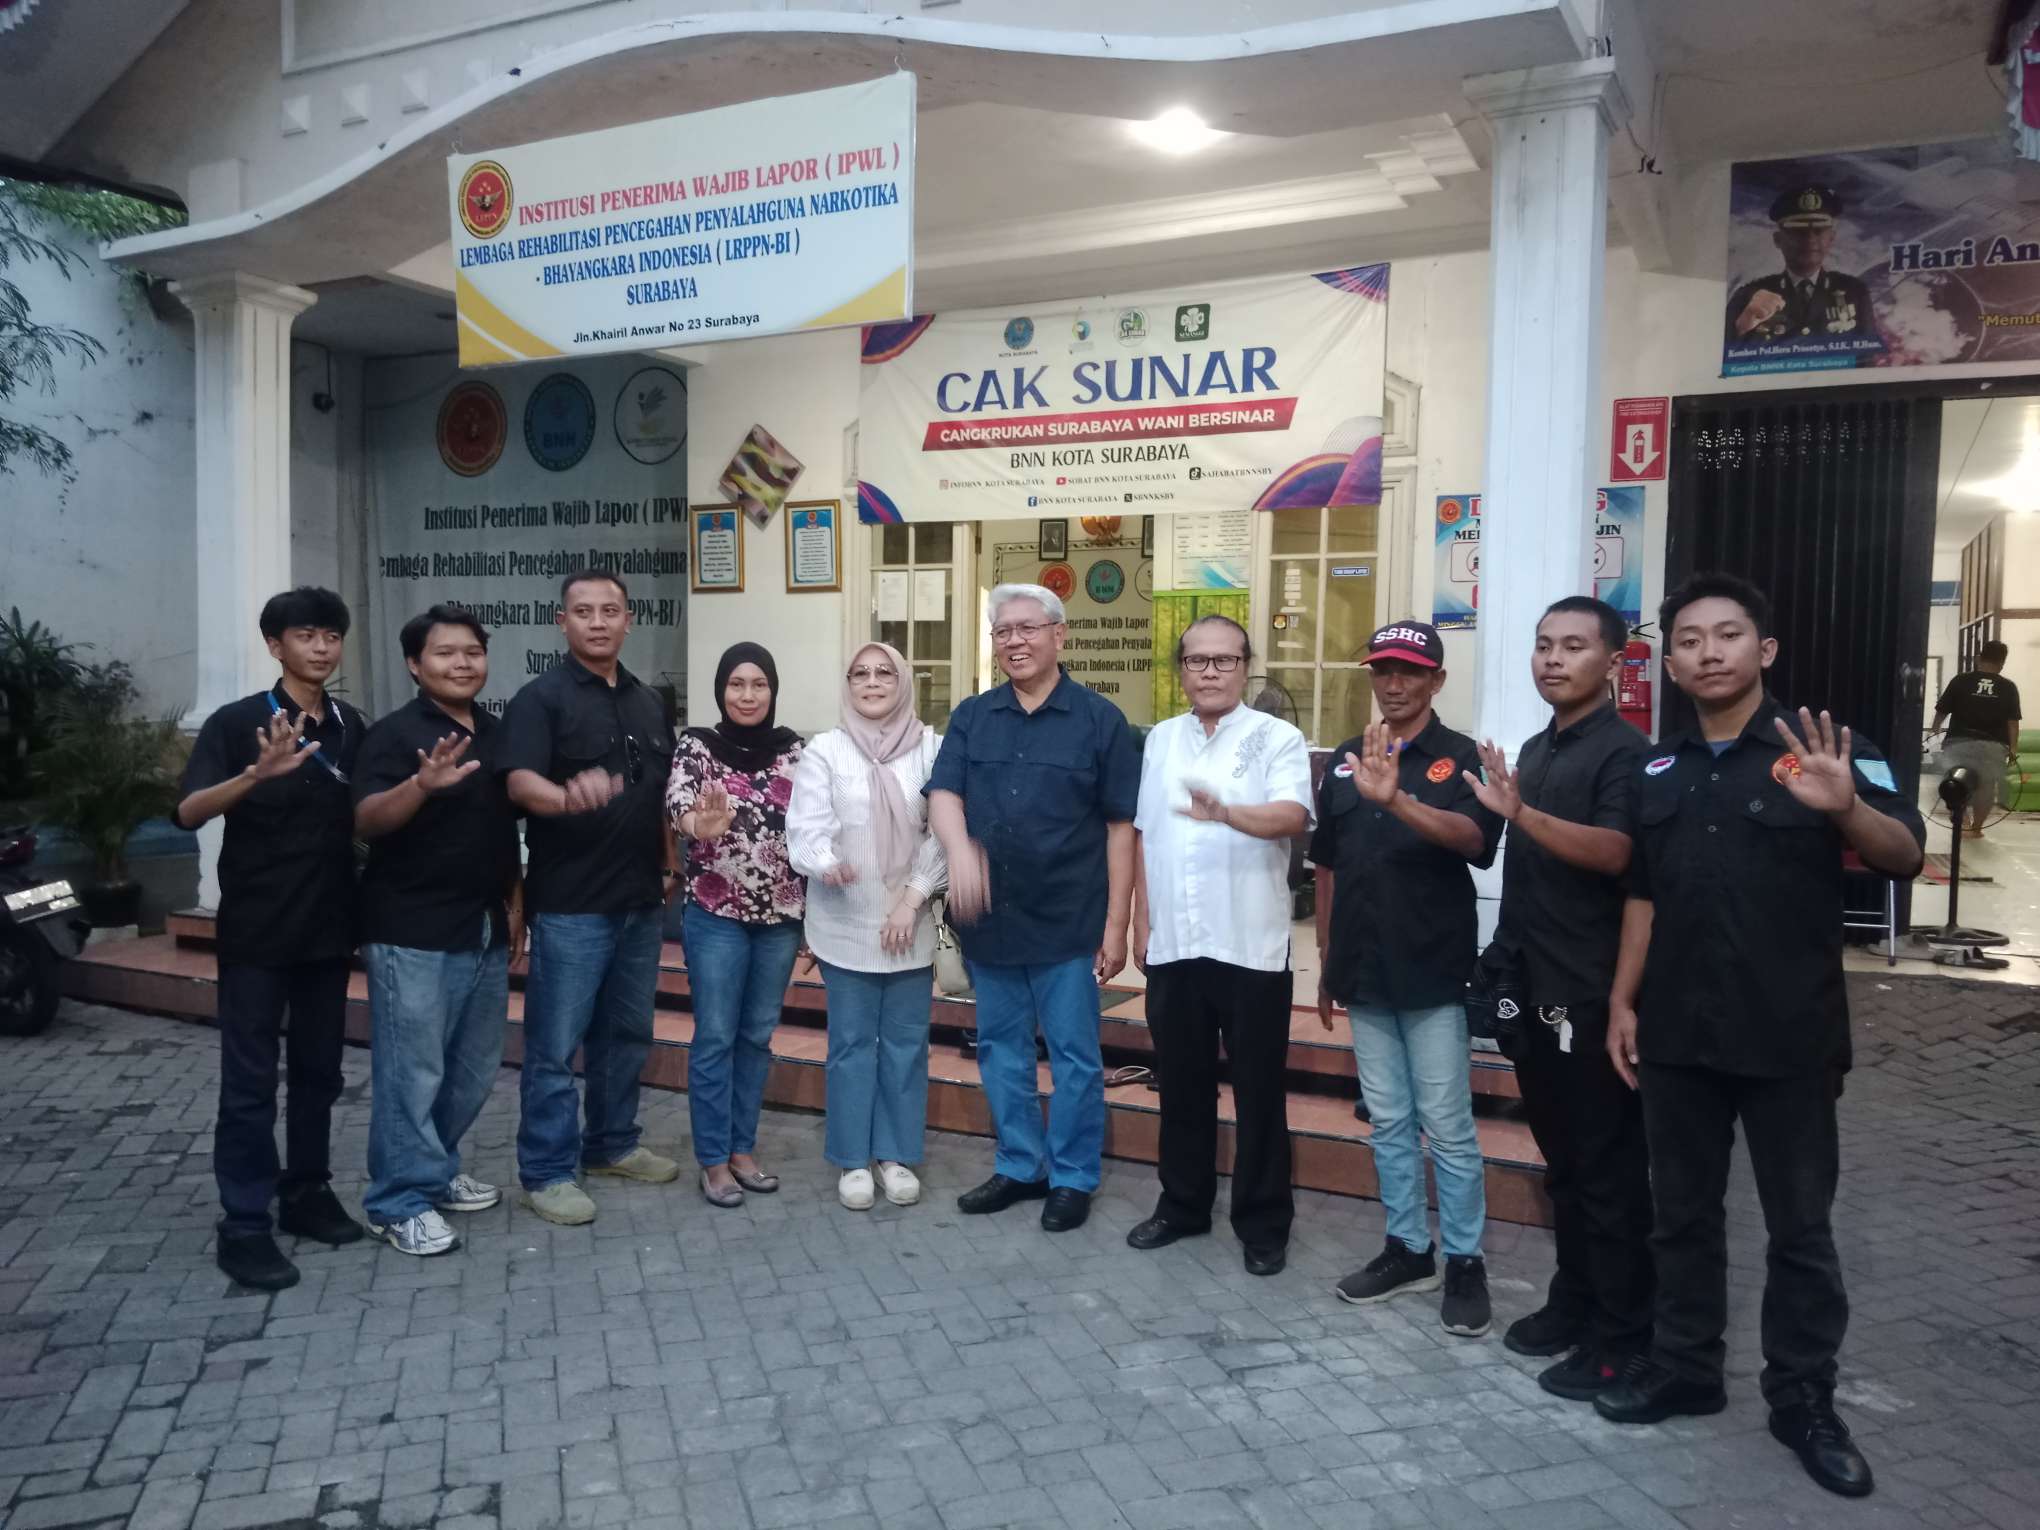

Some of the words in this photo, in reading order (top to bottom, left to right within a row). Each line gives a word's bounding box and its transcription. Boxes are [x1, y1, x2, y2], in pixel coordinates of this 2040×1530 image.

[519, 193, 595, 225] INSTITUSI
[600, 179, 687, 213] PENERIMA
[692, 168, 749, 198] WAJIB
[756, 158, 818, 188] LAPOR
[837, 147, 886, 175] IPWL
[460, 242, 515, 268] LEMBAGA
[518, 228, 601, 259] REHABILITASI
[605, 213, 691, 246] PENCEGAHAN
[695, 196, 806, 233] PENYALAHGUNA
[810, 182, 899, 216] NARKOTIKA
[543, 255, 636, 286] BHAYANGKARA
[639, 242, 712, 273] INDONESIA
[725, 231, 791, 261] LRPPN-BI
[1889, 239, 1976, 272] Hari
[1984, 235, 2040, 266] An
[626, 276, 698, 306] SURABAYA
[573, 327, 627, 344] Jln.Khairil
[630, 325, 665, 338] Anwar
[669, 320, 685, 332] No
[688, 318, 702, 330] 23
[705, 313, 760, 328] Surabaya
[1978, 314, 2040, 326] "Memut
[936, 365, 1050, 413] CAK
[1072, 346, 1280, 405] SUNAR
[940, 423, 1044, 442] CANGKRUKAN
[1048, 418, 1133, 437] SURABAYA
[1137, 415, 1184, 431] WANI
[1188, 408, 1275, 428] BERSINAR
[1010, 451, 1045, 469] BNN
[1052, 449, 1095, 467] KOTA
[1100, 443, 1190, 464] SURABAYA
[424, 506, 477, 530] Institusi
[481, 504, 548, 529] Penerima
[552, 501, 591, 528] Wajib
[595, 500, 640, 527] Lapor
[380, 553, 428, 580] embaga
[432, 550, 506, 578] Rehabilitasi
[509, 550, 585, 579] Pencegahan
[589, 548, 687, 579] Penyalahguna
[1066, 618, 1097, 629] enerima
[1100, 617, 1123, 631] Wajib
[1125, 617, 1149, 631] Lapor
[1374, 628, 1428, 646] SSHC
[1075, 637, 1120, 650] Pencegahan
[1121, 637, 1152, 651] Penyala
[1090, 659, 1125, 672] Indonesia
